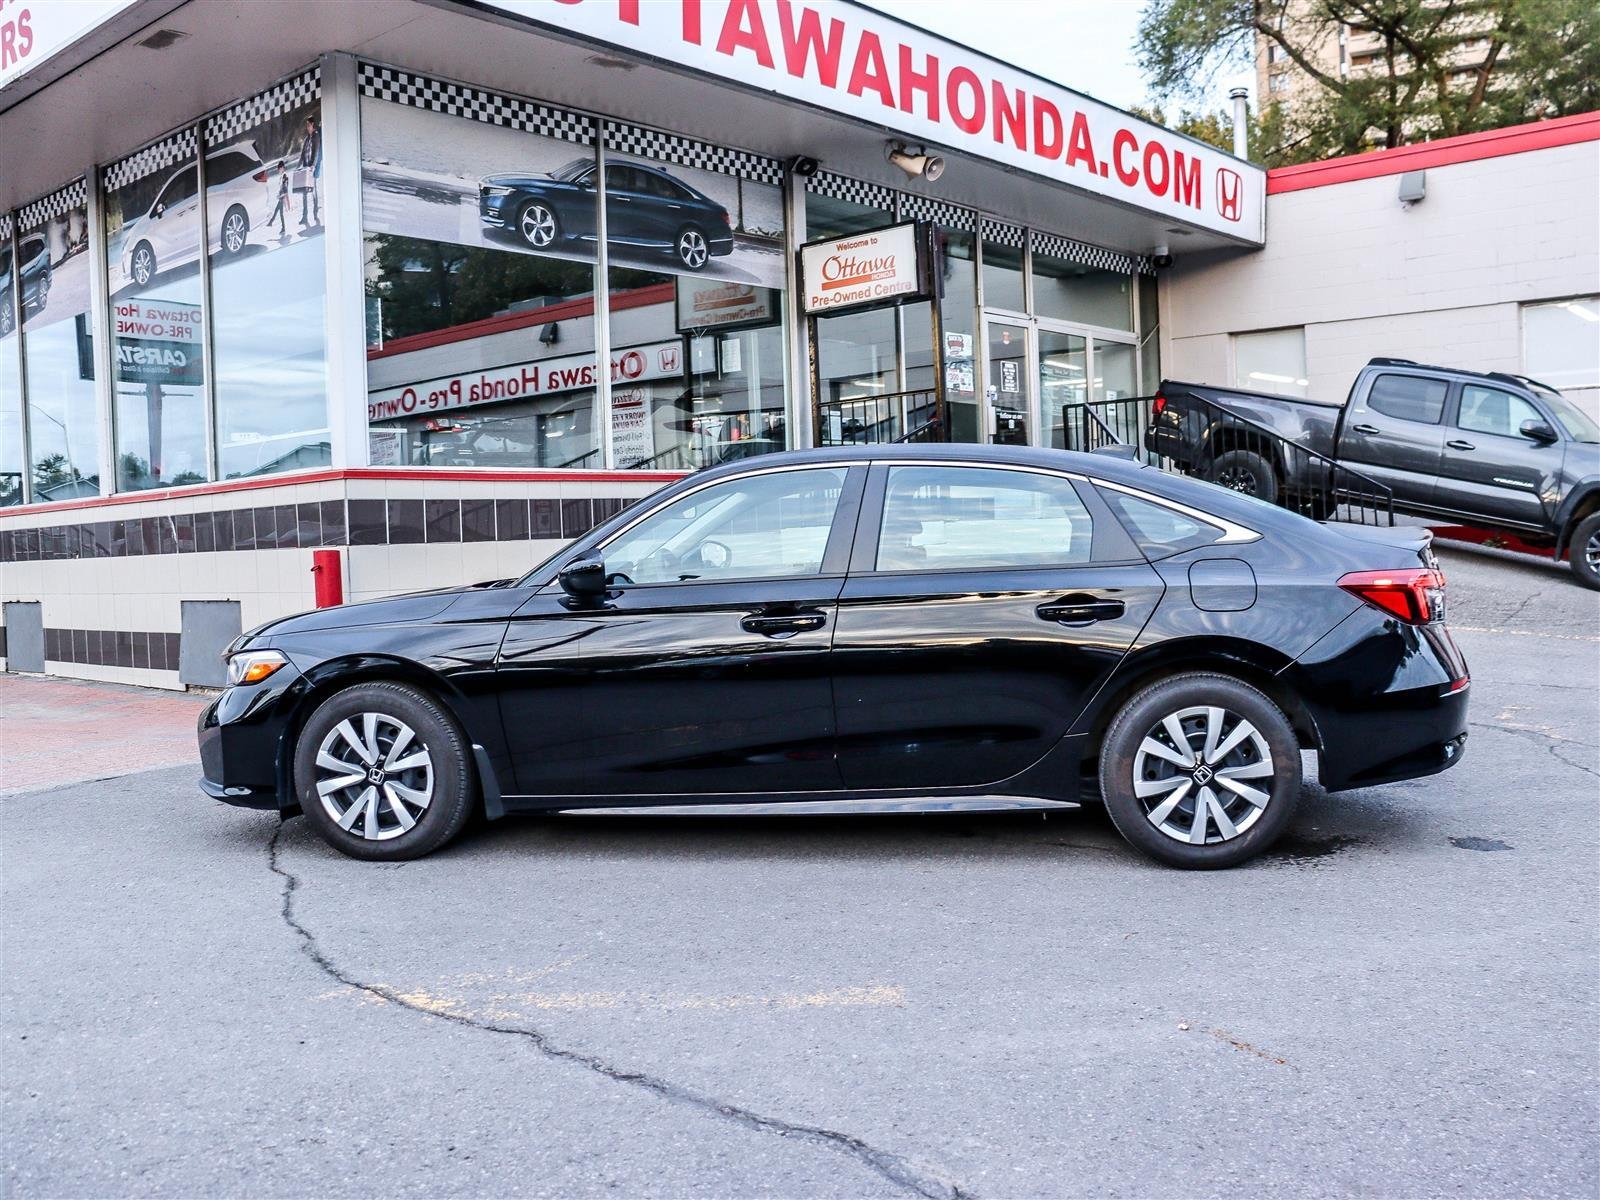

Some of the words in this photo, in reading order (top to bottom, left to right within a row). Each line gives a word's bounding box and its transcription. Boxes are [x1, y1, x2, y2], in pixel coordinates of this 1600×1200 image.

[553, 0, 1202, 210] AWAHONDA.COM
[836, 240, 869, 252] Welcome
[871, 238, 878, 246] to
[822, 255, 896, 281] Ottawa
[812, 286, 871, 307] Pre-Owned
